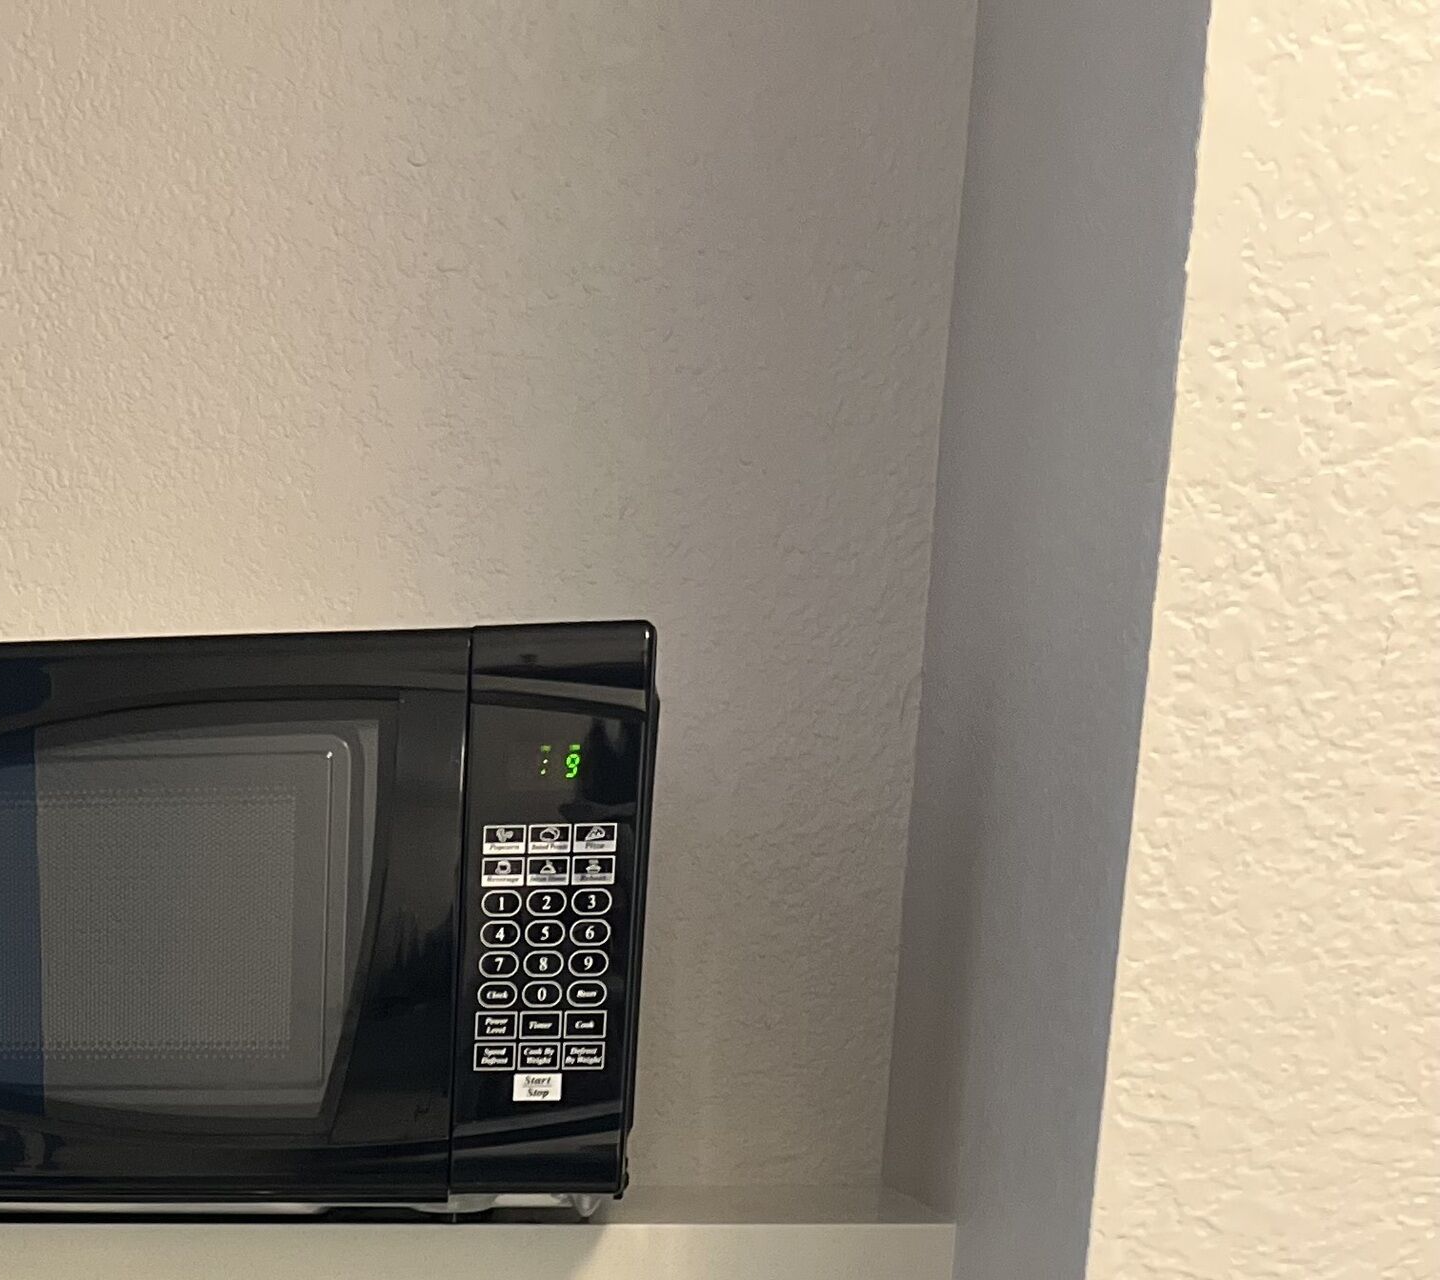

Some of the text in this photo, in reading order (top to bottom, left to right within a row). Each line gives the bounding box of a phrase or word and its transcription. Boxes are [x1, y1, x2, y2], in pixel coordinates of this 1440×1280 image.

[542, 895, 551, 910] 2
[587, 894, 596, 909] 3
[495, 927, 505, 941] 4
[540, 926, 550, 940] 5
[585, 925, 595, 940] 6
[494, 957, 504, 972] 7
[539, 956, 548, 971] 8
[583, 956, 593, 970] 9
[486, 990, 508, 999] Clock
[537, 987, 547, 1001] 0
[485, 1017, 508, 1025] Power
[529, 1021, 552, 1029] Timer
[486, 1026, 506, 1034] Level
[525, 1076, 551, 1085] Start
[527, 1088, 549, 1098] Stop
